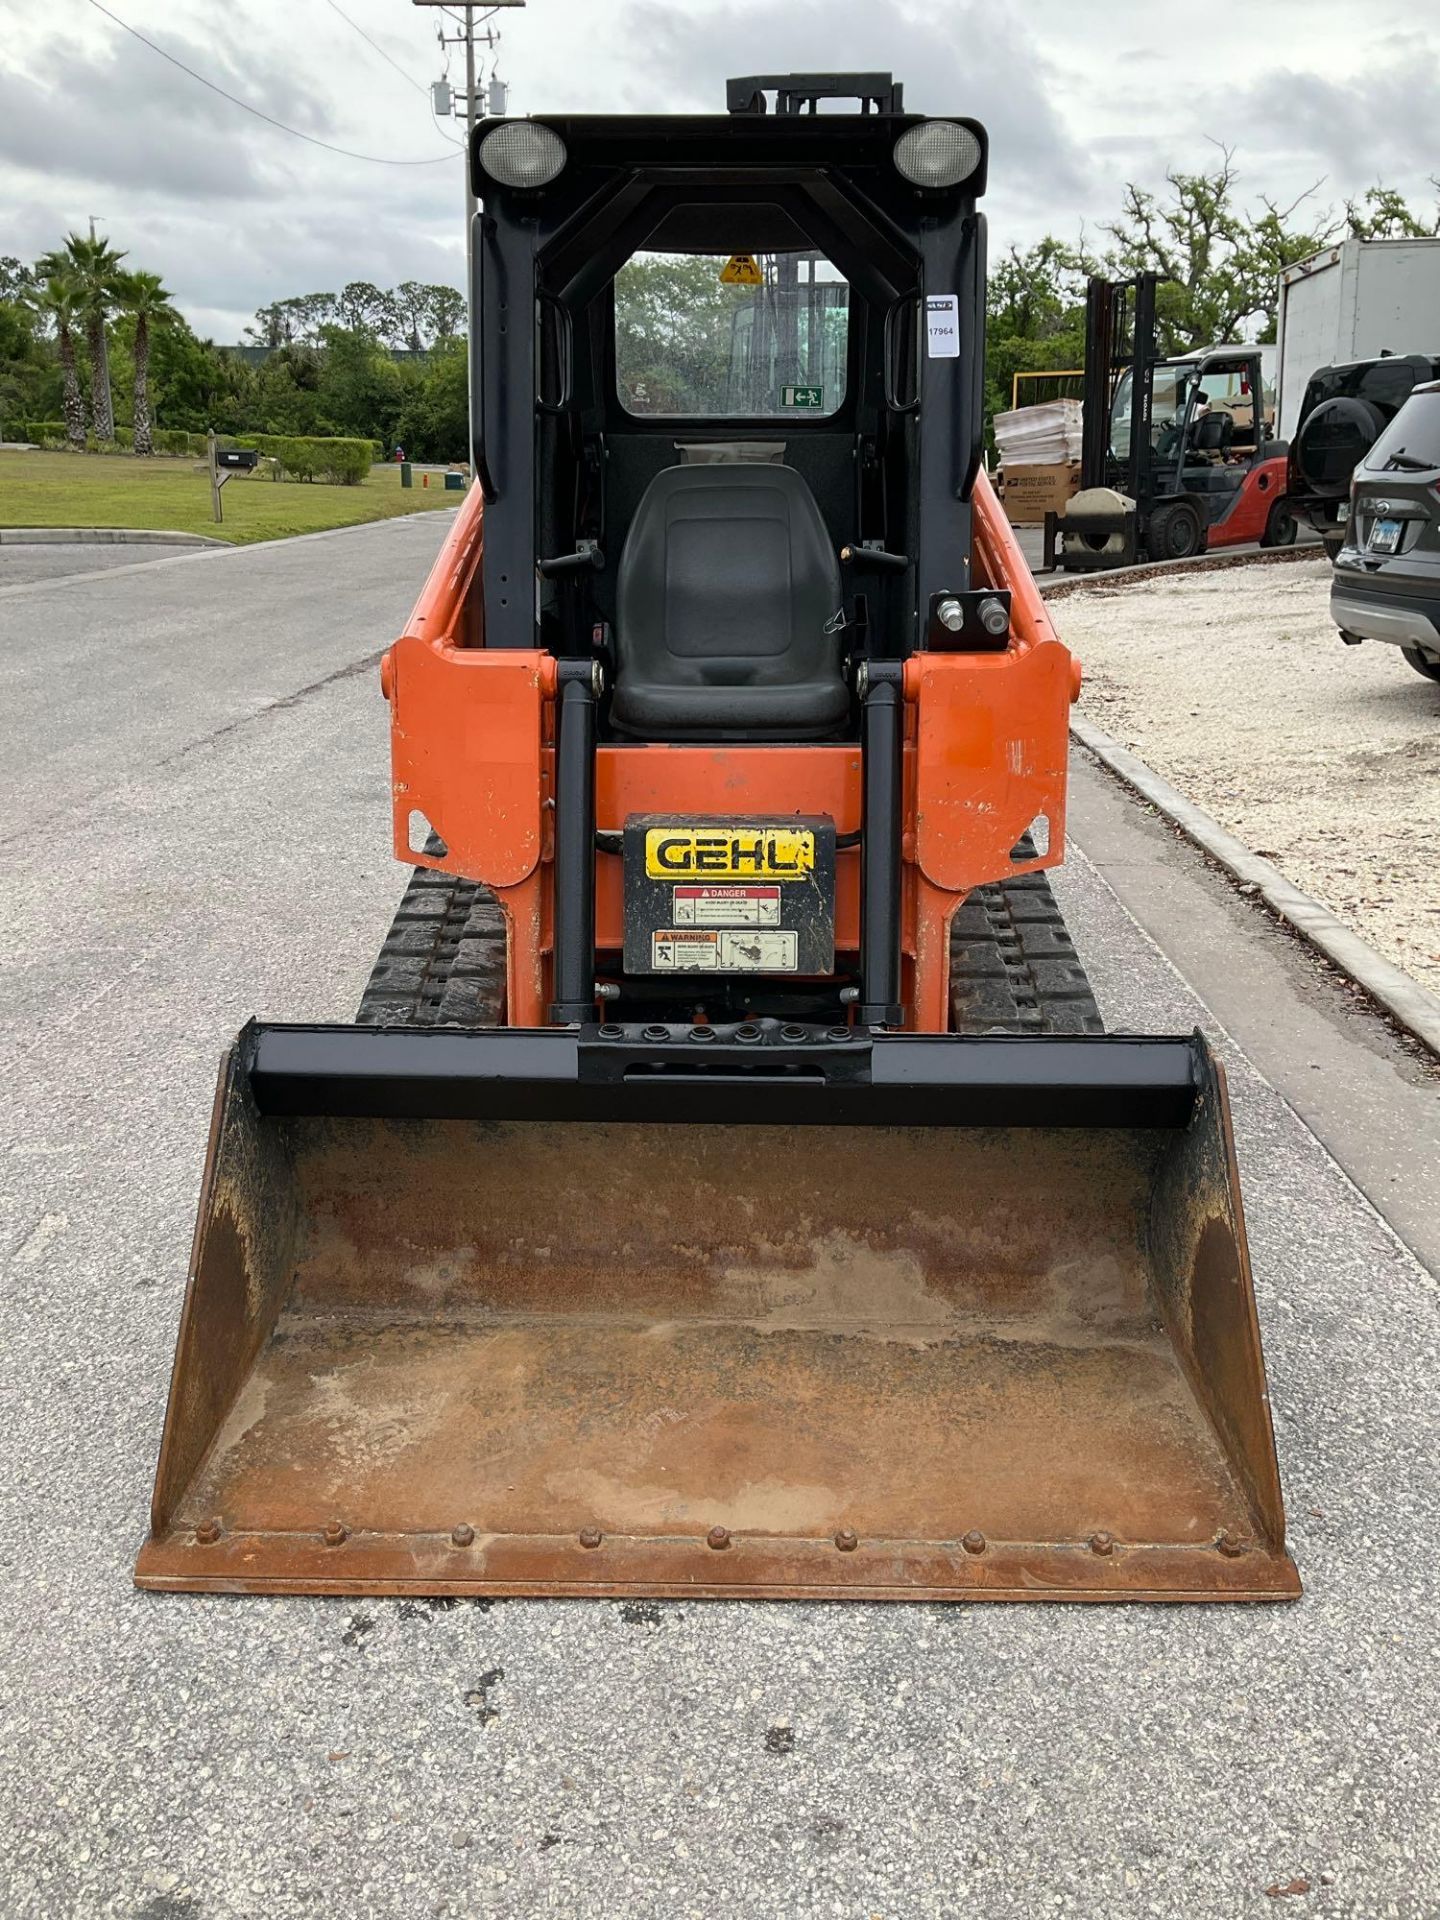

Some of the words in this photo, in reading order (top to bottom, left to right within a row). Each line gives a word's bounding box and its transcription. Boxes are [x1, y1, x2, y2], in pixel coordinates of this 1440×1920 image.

[929, 327, 953, 336] 17964
[657, 838, 798, 870] GEHL
[711, 889, 746, 897] DANGER
[670, 934, 711, 942] WARNING
